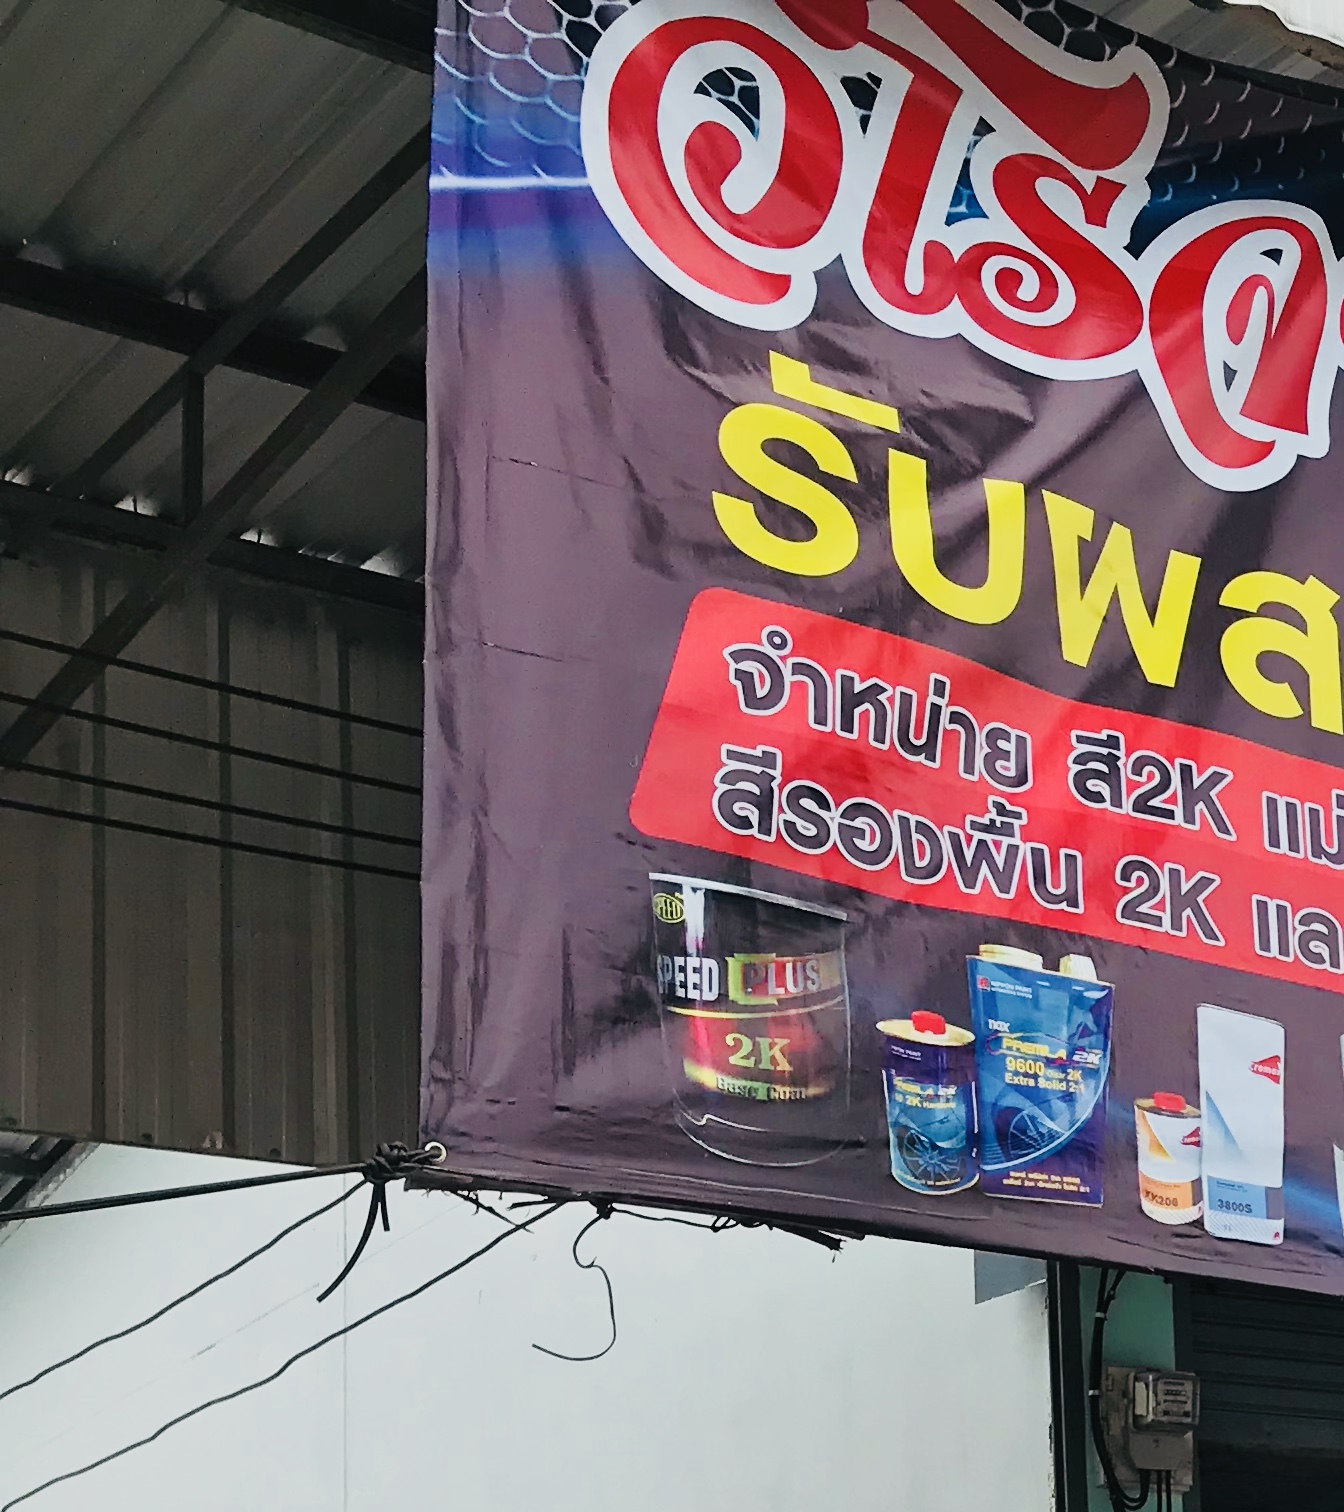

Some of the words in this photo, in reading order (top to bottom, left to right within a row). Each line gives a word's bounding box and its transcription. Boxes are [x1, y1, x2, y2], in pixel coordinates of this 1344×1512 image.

[723, 626, 1033, 793] จำหน่าย
[1069, 730, 1237, 841] สี2K
[713, 745, 1084, 914] สีรองพื้น
[1114, 855, 1226, 947] 2K
[725, 1032, 793, 1072] 2K
[1005, 1057, 1045, 1076] 9600
[1217, 1199, 1253, 1214] 3800S
